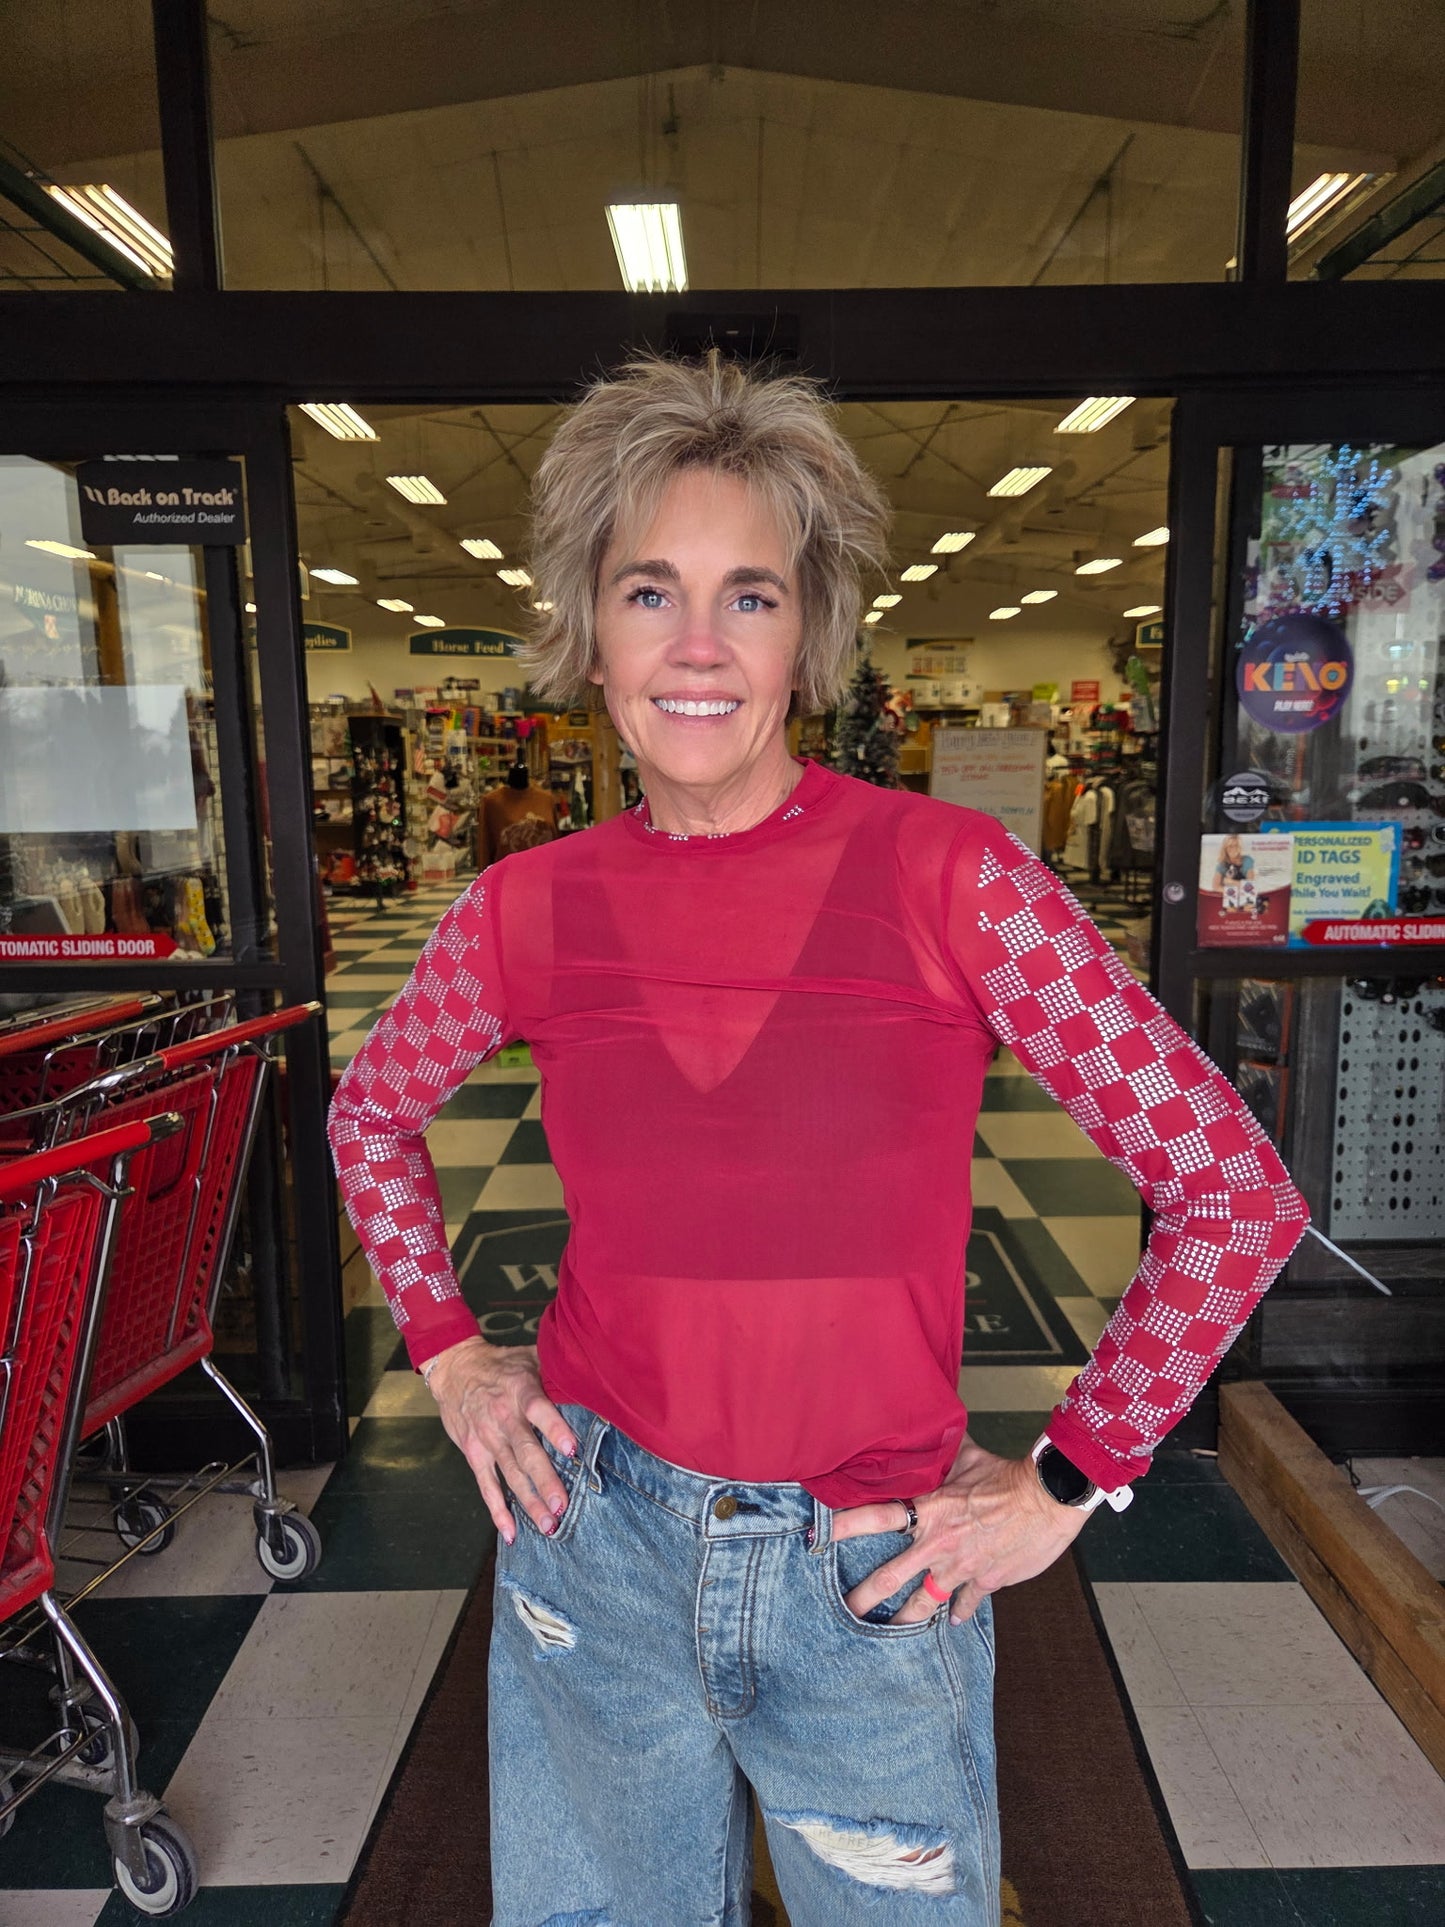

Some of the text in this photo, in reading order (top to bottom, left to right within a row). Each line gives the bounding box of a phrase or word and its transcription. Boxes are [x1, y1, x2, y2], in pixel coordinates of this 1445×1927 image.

[107, 488, 234, 506] Back on Track
[133, 512, 235, 524] Authorized Dealer
[432, 639, 504, 655] Horse Feed
[1243, 662, 1347, 692] KENO
[1297, 850, 1361, 864] ID TAGS
[1296, 872, 1360, 886] Engraved
[1291, 886, 1371, 898] hile You Wait!
[1324, 924, 1401, 940] AUTOMATIC
[61, 940, 114, 956] SLIDING
[117, 939, 155, 955] DOOR
